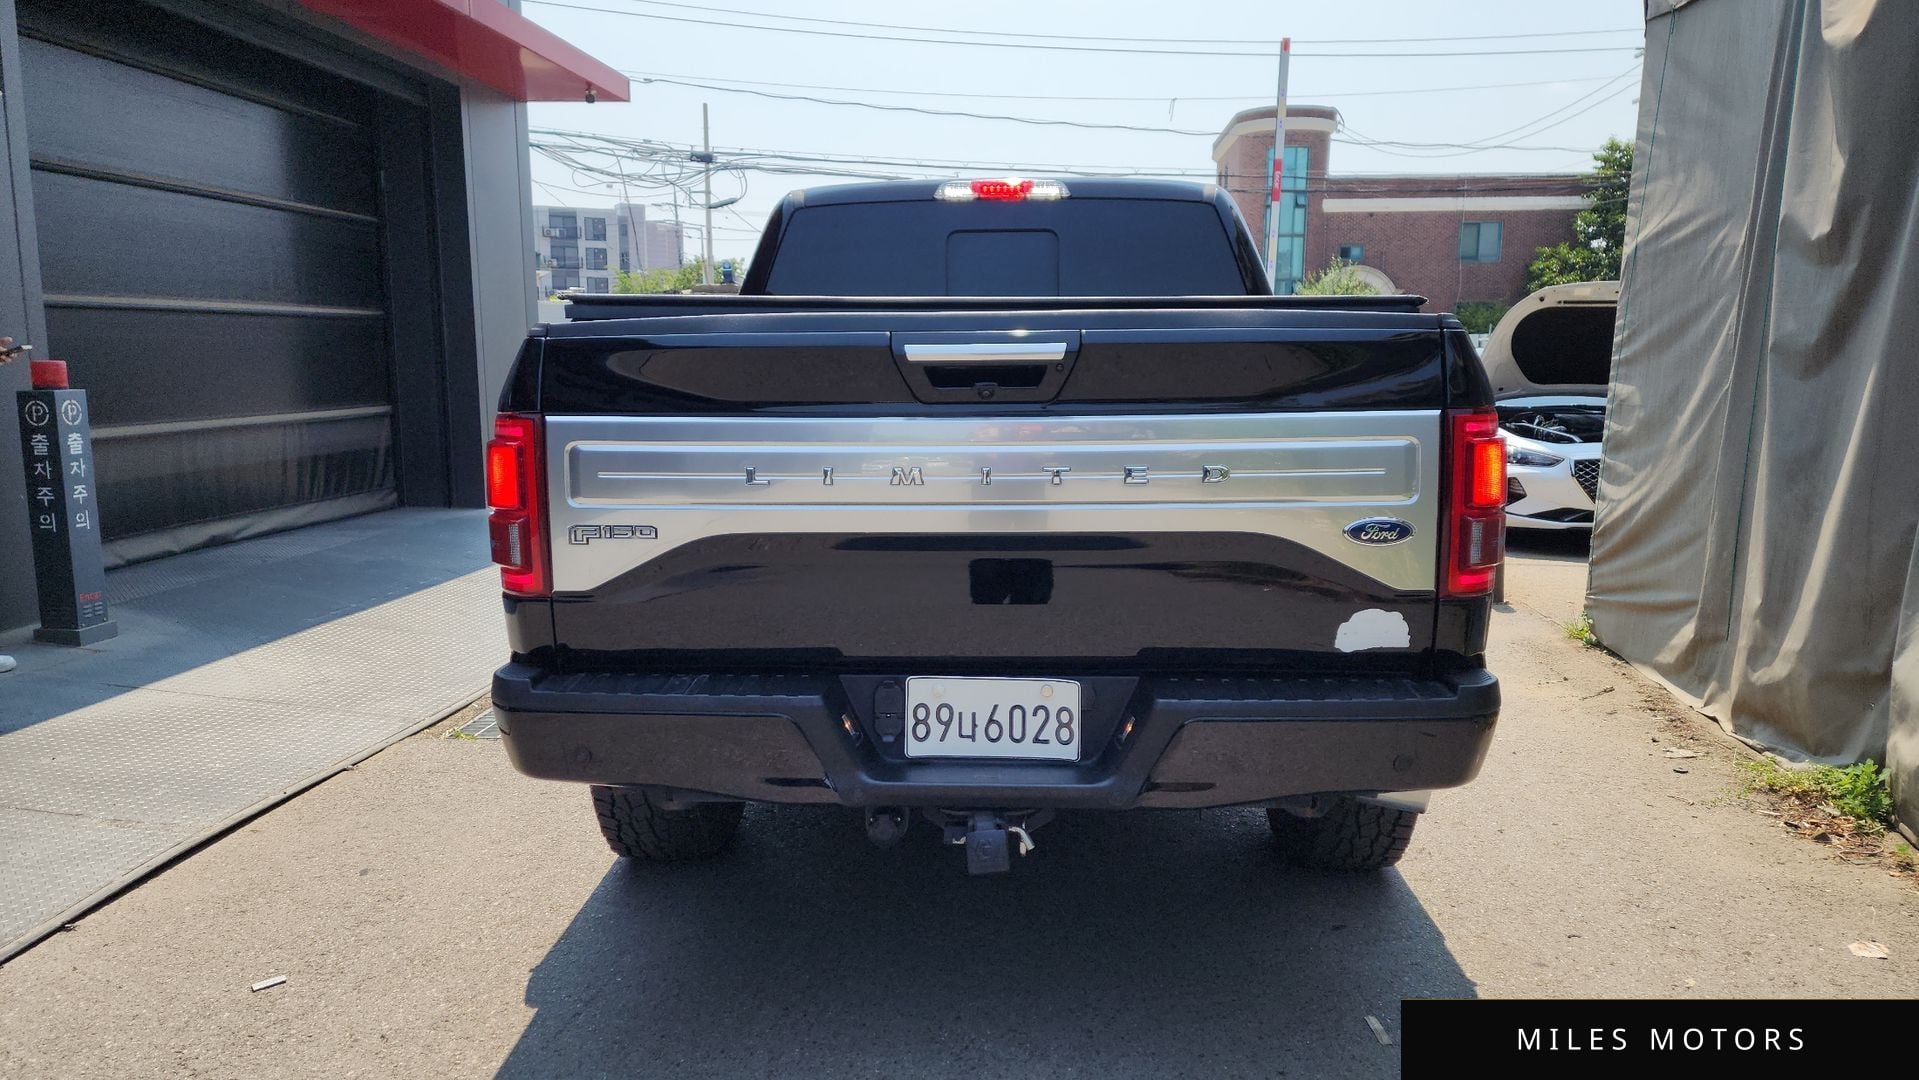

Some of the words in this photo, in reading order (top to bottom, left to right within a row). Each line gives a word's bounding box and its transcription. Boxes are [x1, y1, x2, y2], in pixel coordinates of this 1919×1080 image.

[745, 464, 1231, 486] LIMITED
[1361, 523, 1400, 540] Ford
[911, 702, 1075, 746] 89나6028
